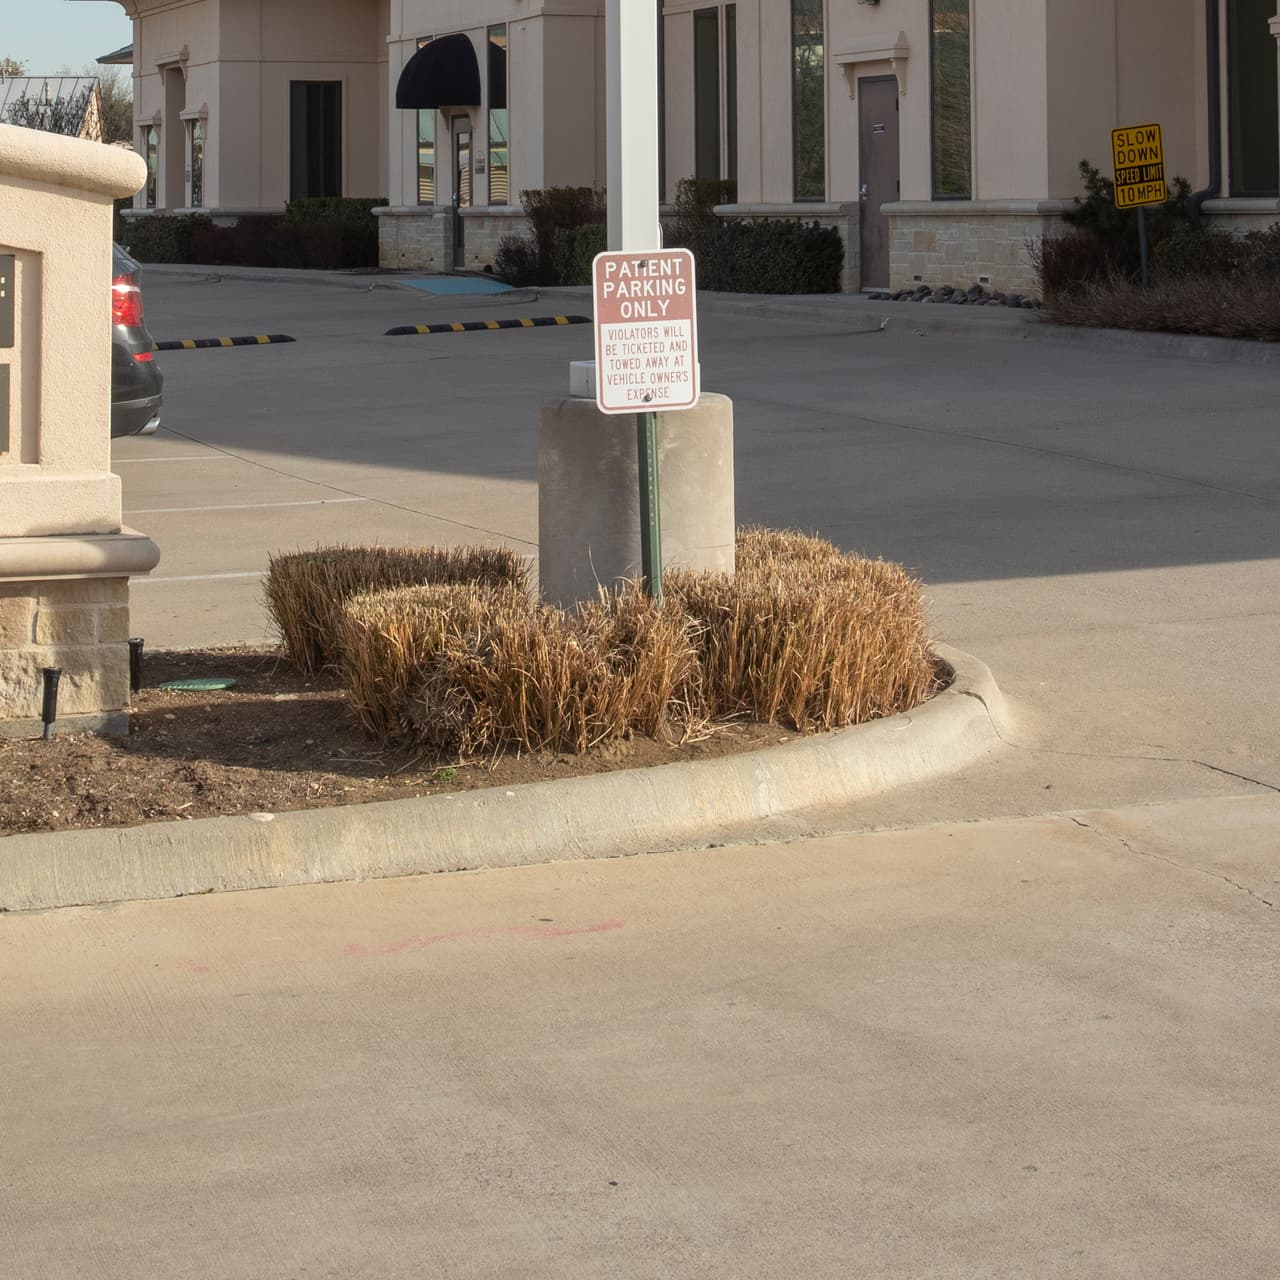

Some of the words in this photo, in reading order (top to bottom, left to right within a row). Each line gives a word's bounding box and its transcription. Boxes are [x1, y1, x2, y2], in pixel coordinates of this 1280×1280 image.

[1117, 129, 1156, 147] SLOW
[1117, 146, 1159, 165] DOWN
[1116, 168, 1140, 185] SPEED
[1143, 165, 1163, 181] LIMIT
[1120, 187, 1135, 203] 10
[1138, 184, 1163, 200] MPH
[605, 258, 683, 279] PATIENT
[603, 278, 686, 299] PARKING
[620, 299, 670, 319] ONLY
[608, 327, 659, 341] VIOLATORS
[663, 325, 685, 338] WILL
[605, 344, 618, 356] BE
[622, 341, 665, 355] TICKETED
[669, 340, 688, 353] AND
[609, 358, 641, 370] TOWED
[645, 356, 670, 369] AWAY
[674, 355, 685, 367] AT
[607, 373, 646, 386] VEHICLE
[650, 371, 689, 384] OWNER'S
[627, 387, 670, 401] EXPENSE
